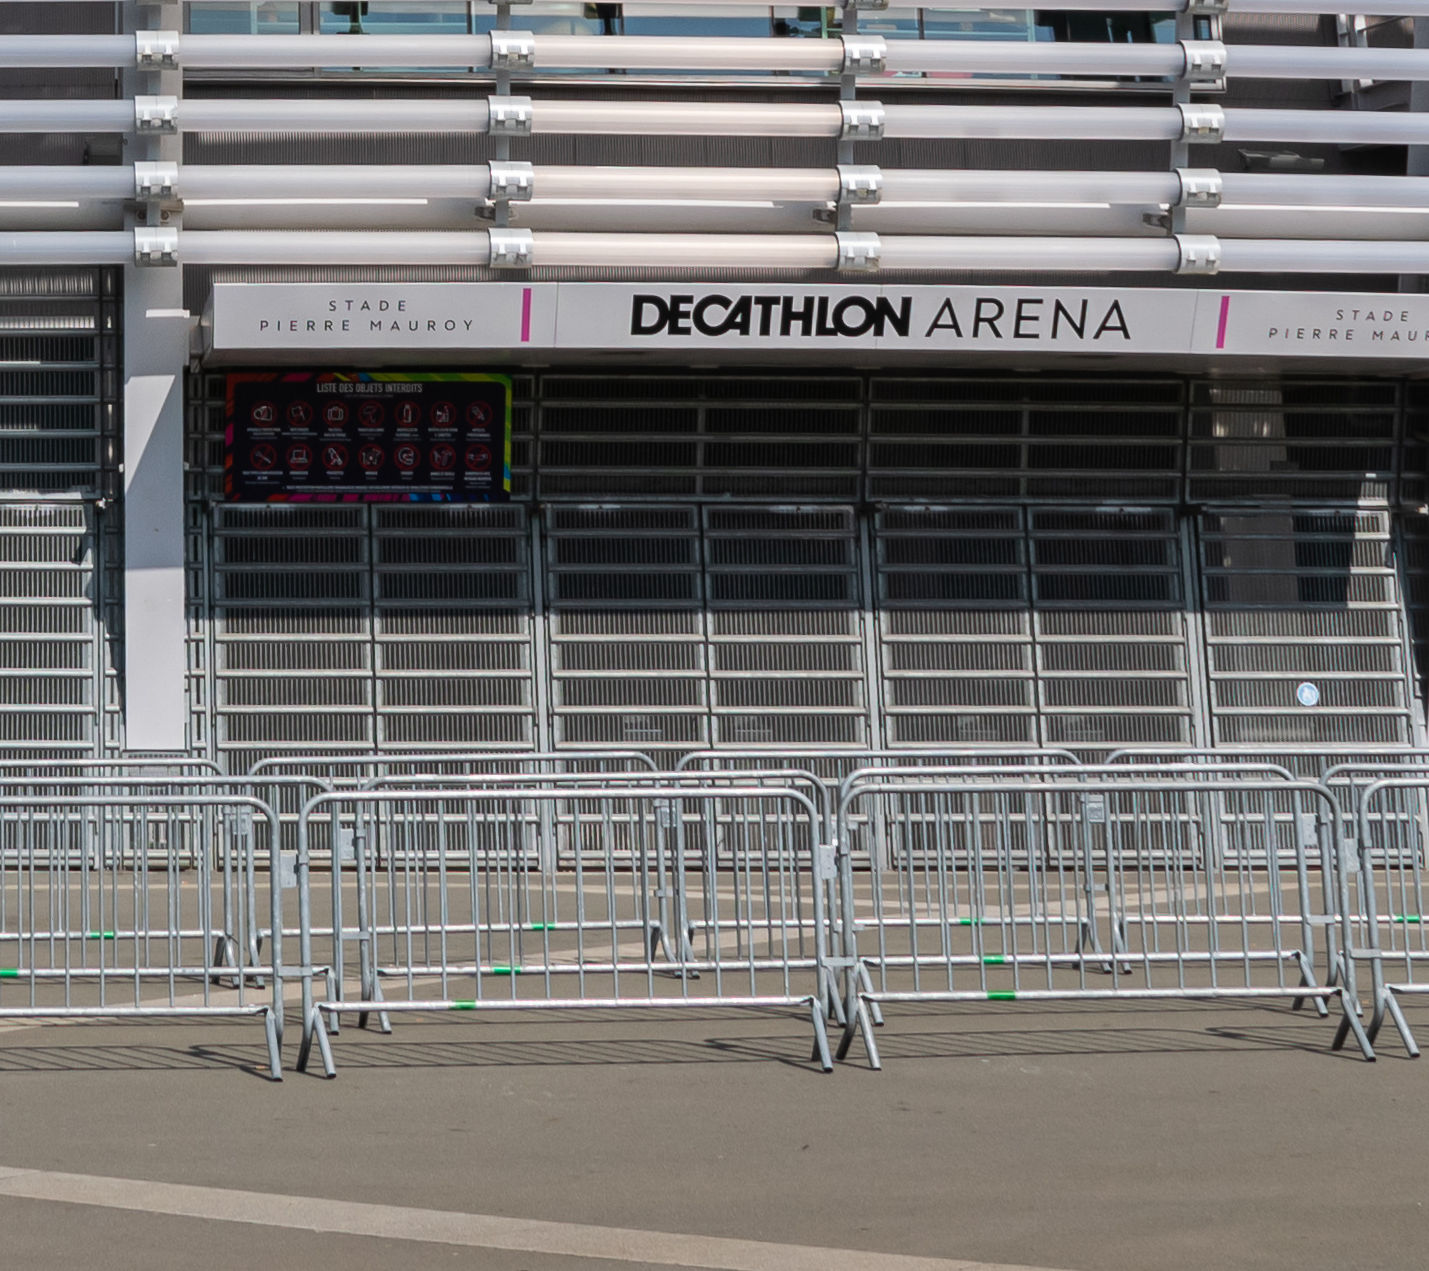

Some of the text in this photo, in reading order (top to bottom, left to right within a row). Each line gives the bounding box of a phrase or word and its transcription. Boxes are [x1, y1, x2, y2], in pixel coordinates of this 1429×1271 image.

[328, 299, 407, 312] STADE
[630, 294, 1132, 340] DECATHLON ARENA
[1335, 308, 1409, 322] STADE
[259, 319, 474, 332] PIERRE MAUROY
[1268, 327, 1354, 341] PIERRE
[316, 383, 423, 393] LISTE DES OBJETS INTERDITS
